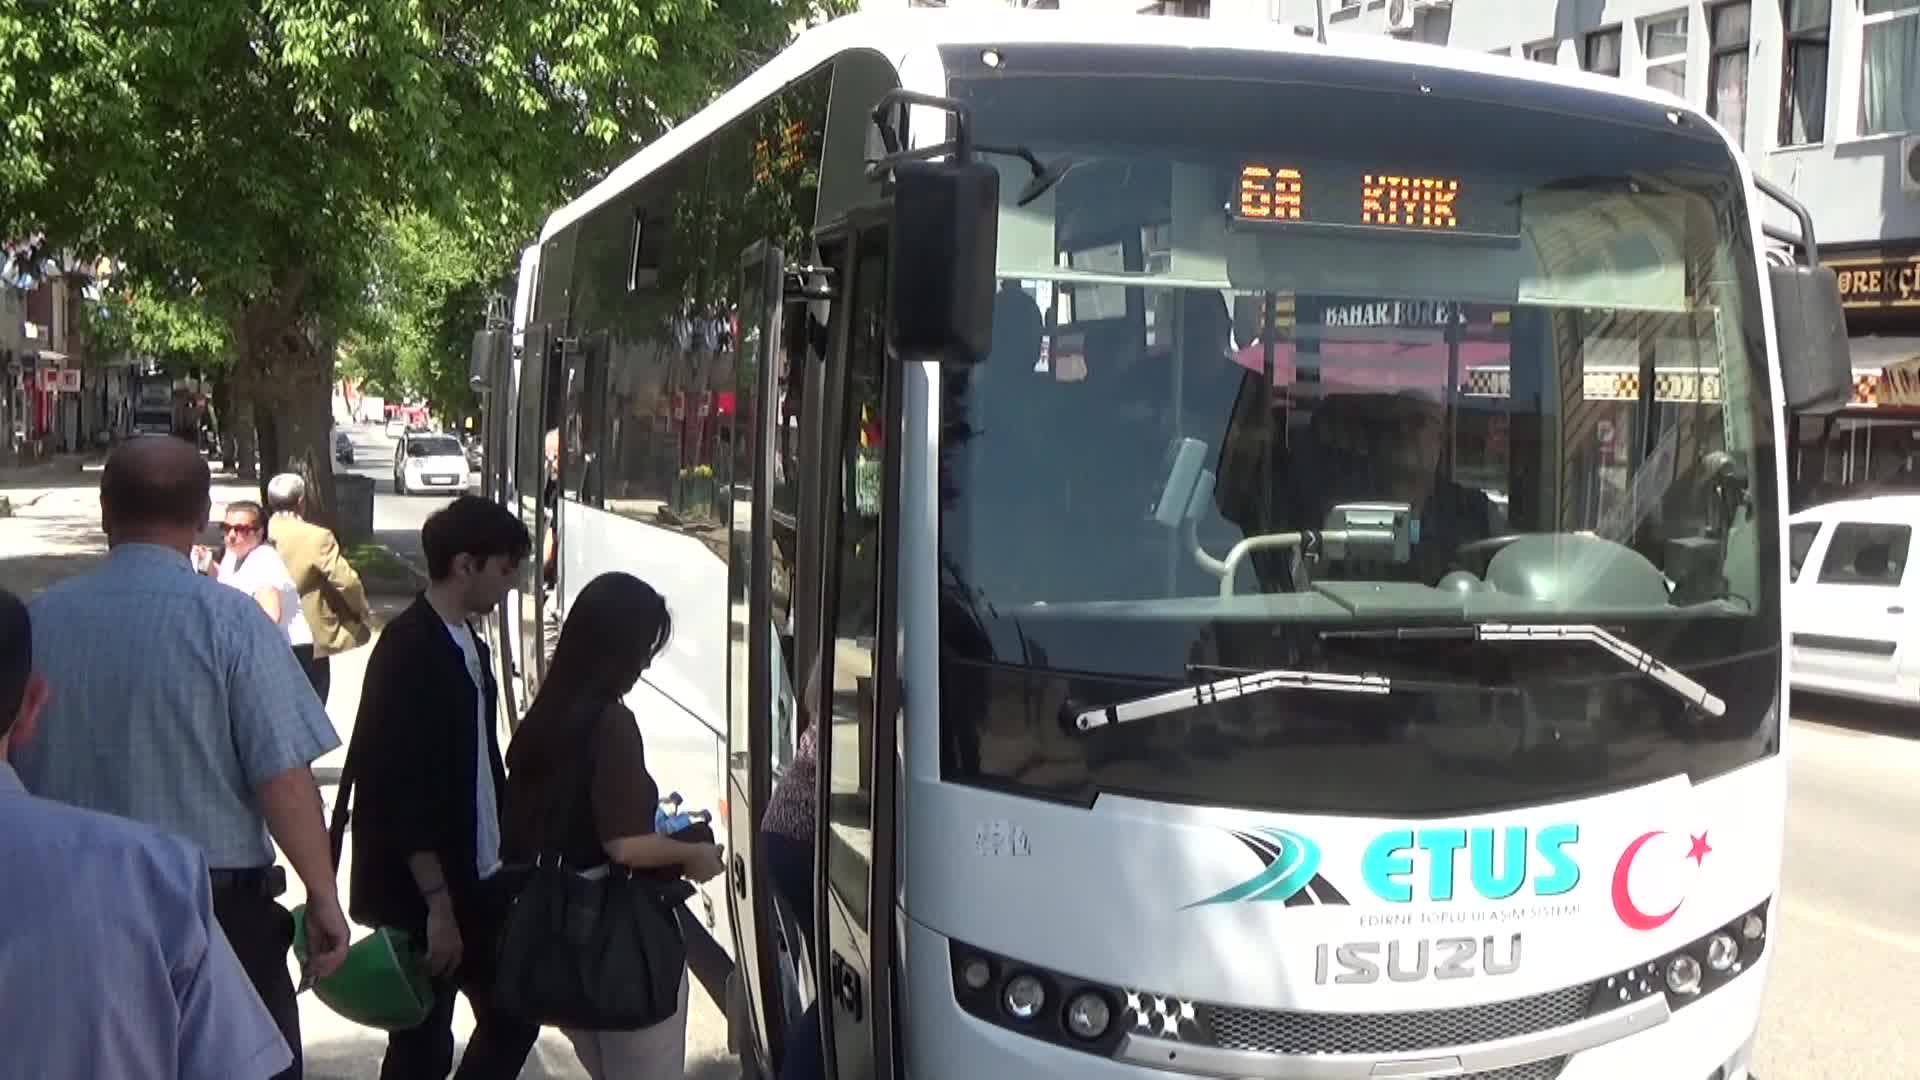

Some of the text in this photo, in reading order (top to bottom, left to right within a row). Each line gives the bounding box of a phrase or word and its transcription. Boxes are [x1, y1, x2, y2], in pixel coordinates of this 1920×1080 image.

[1241, 166, 1301, 218] 6A
[1326, 302, 1390, 326] BAHAR
[1361, 823, 1580, 903] ETUS
[1315, 932, 1522, 985] ISUZU
